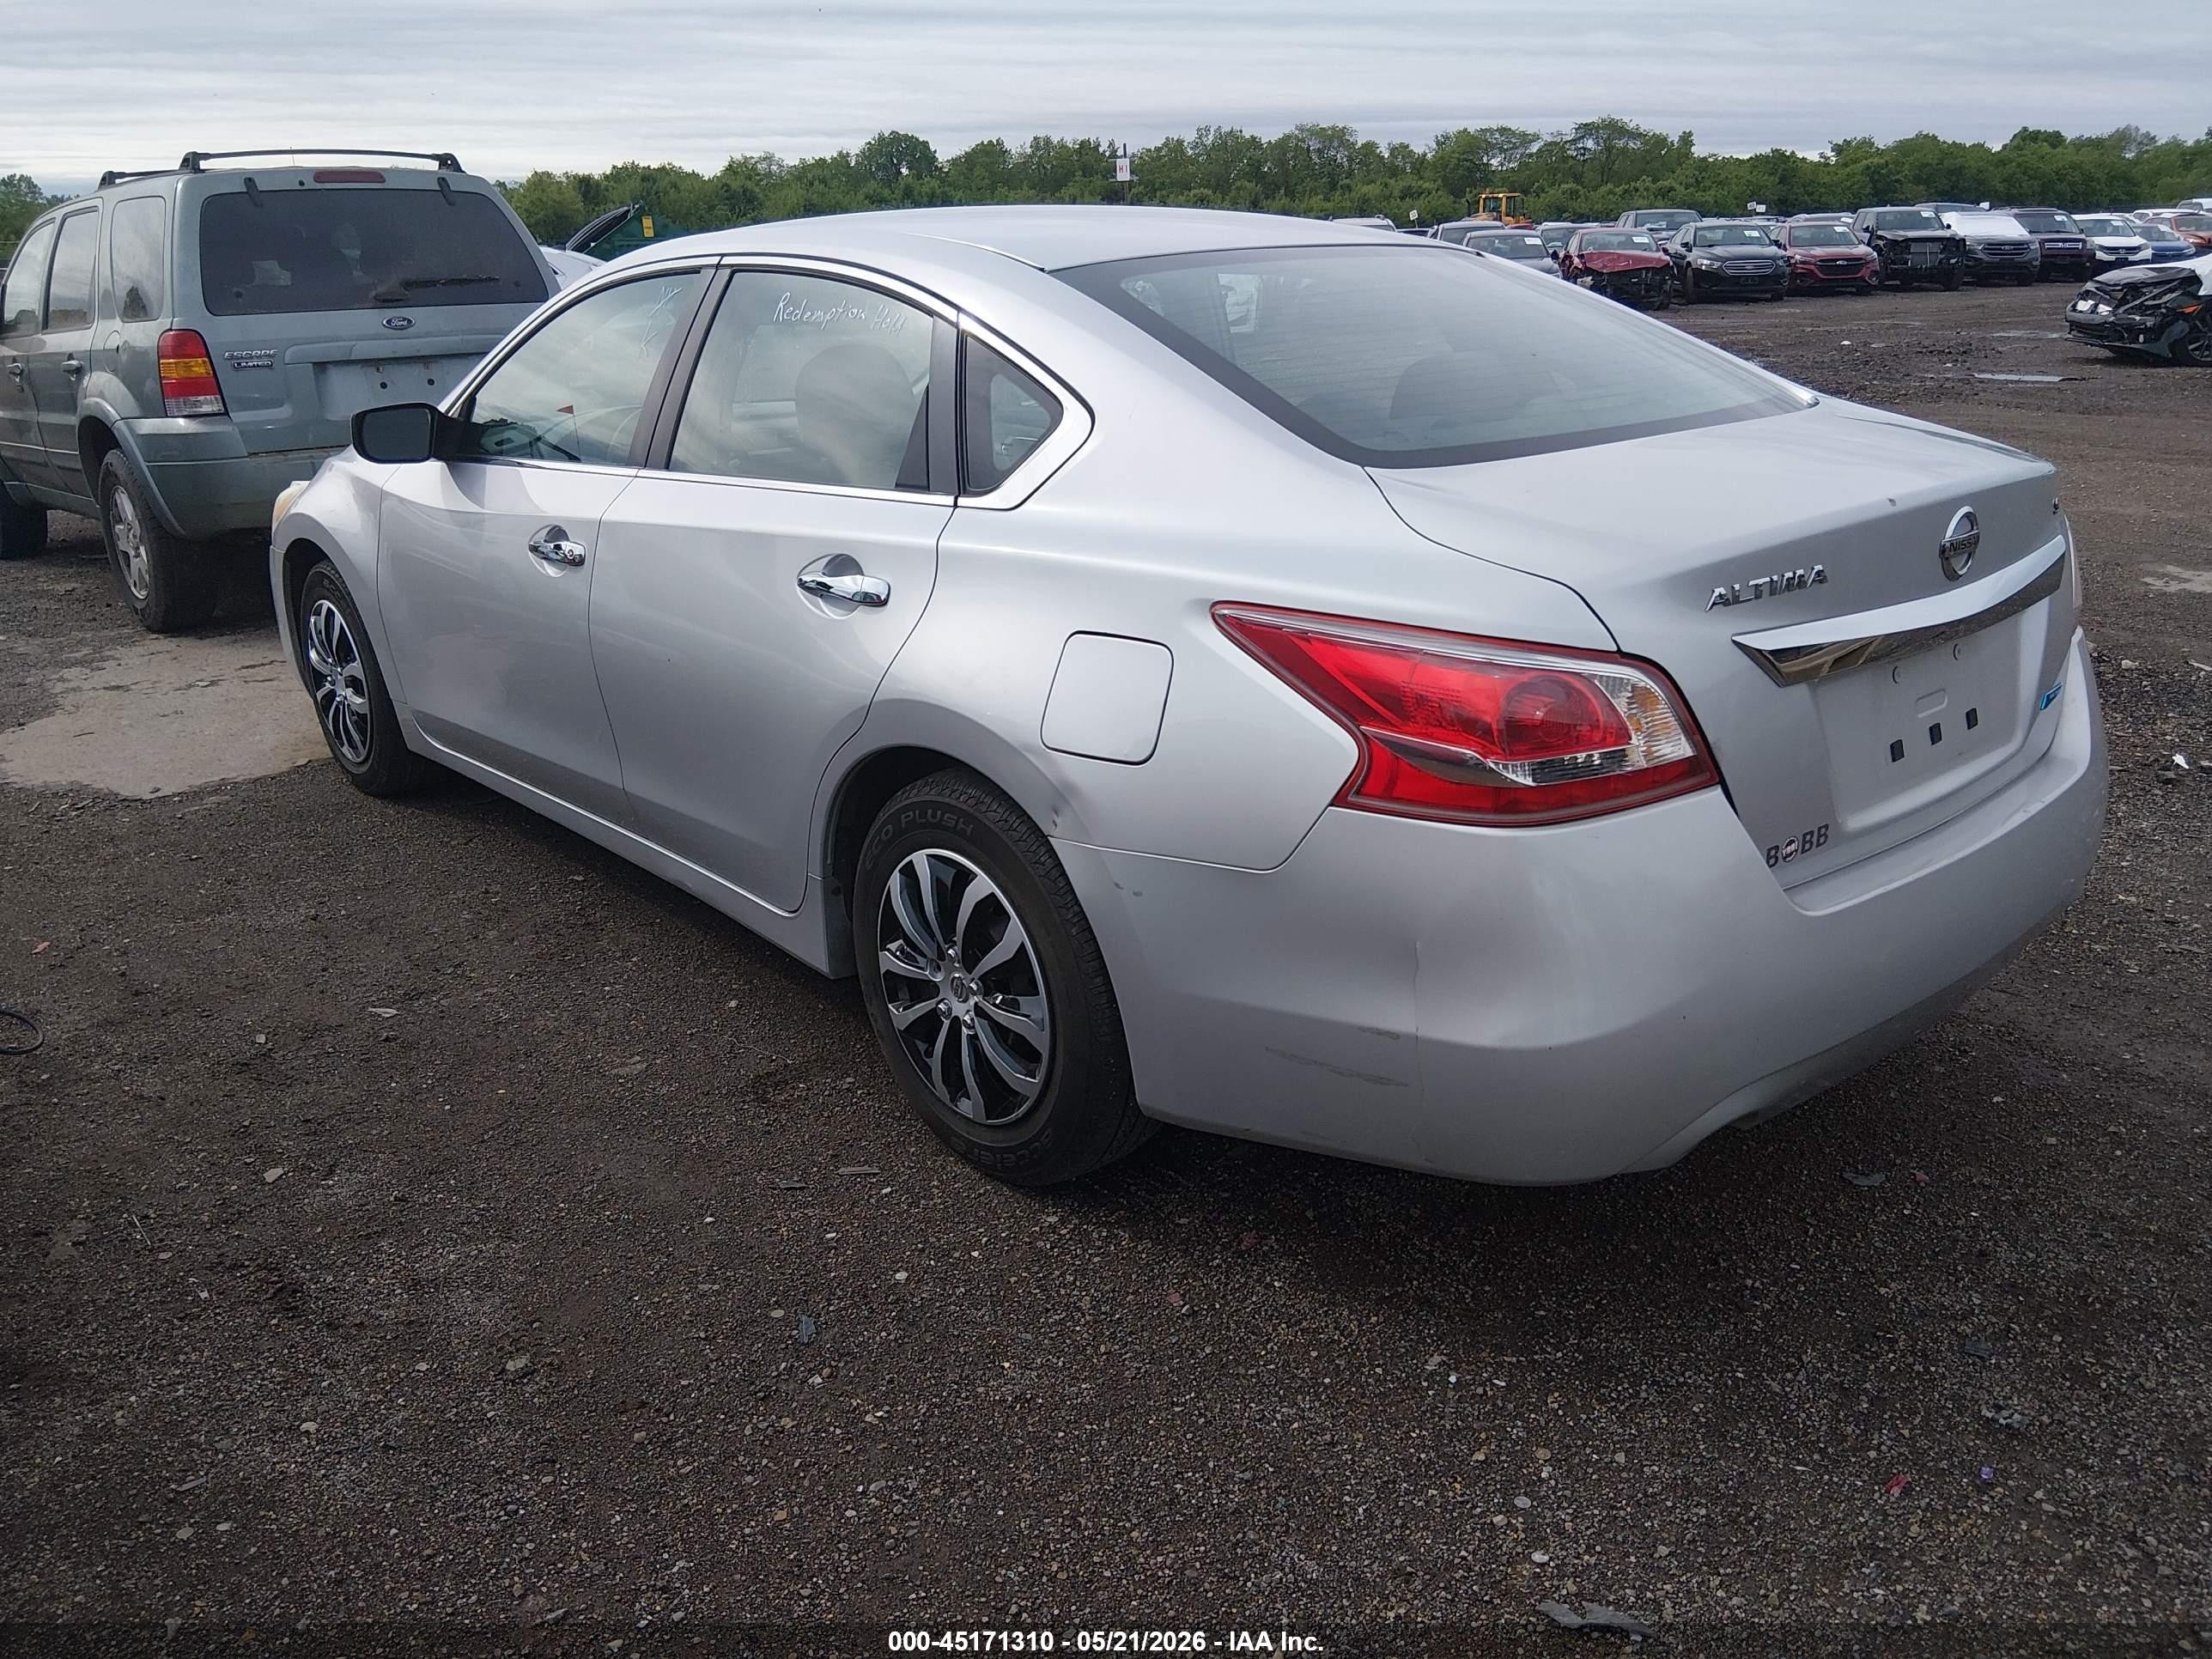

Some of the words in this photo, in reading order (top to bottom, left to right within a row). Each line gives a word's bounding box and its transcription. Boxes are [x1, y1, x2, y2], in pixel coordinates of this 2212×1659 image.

[773, 292, 866, 330] Redemption
[224, 349, 278, 359] ESCAPE
[1705, 564, 1828, 612] ALTIMA
[901, 809, 975, 836] PLUSH
